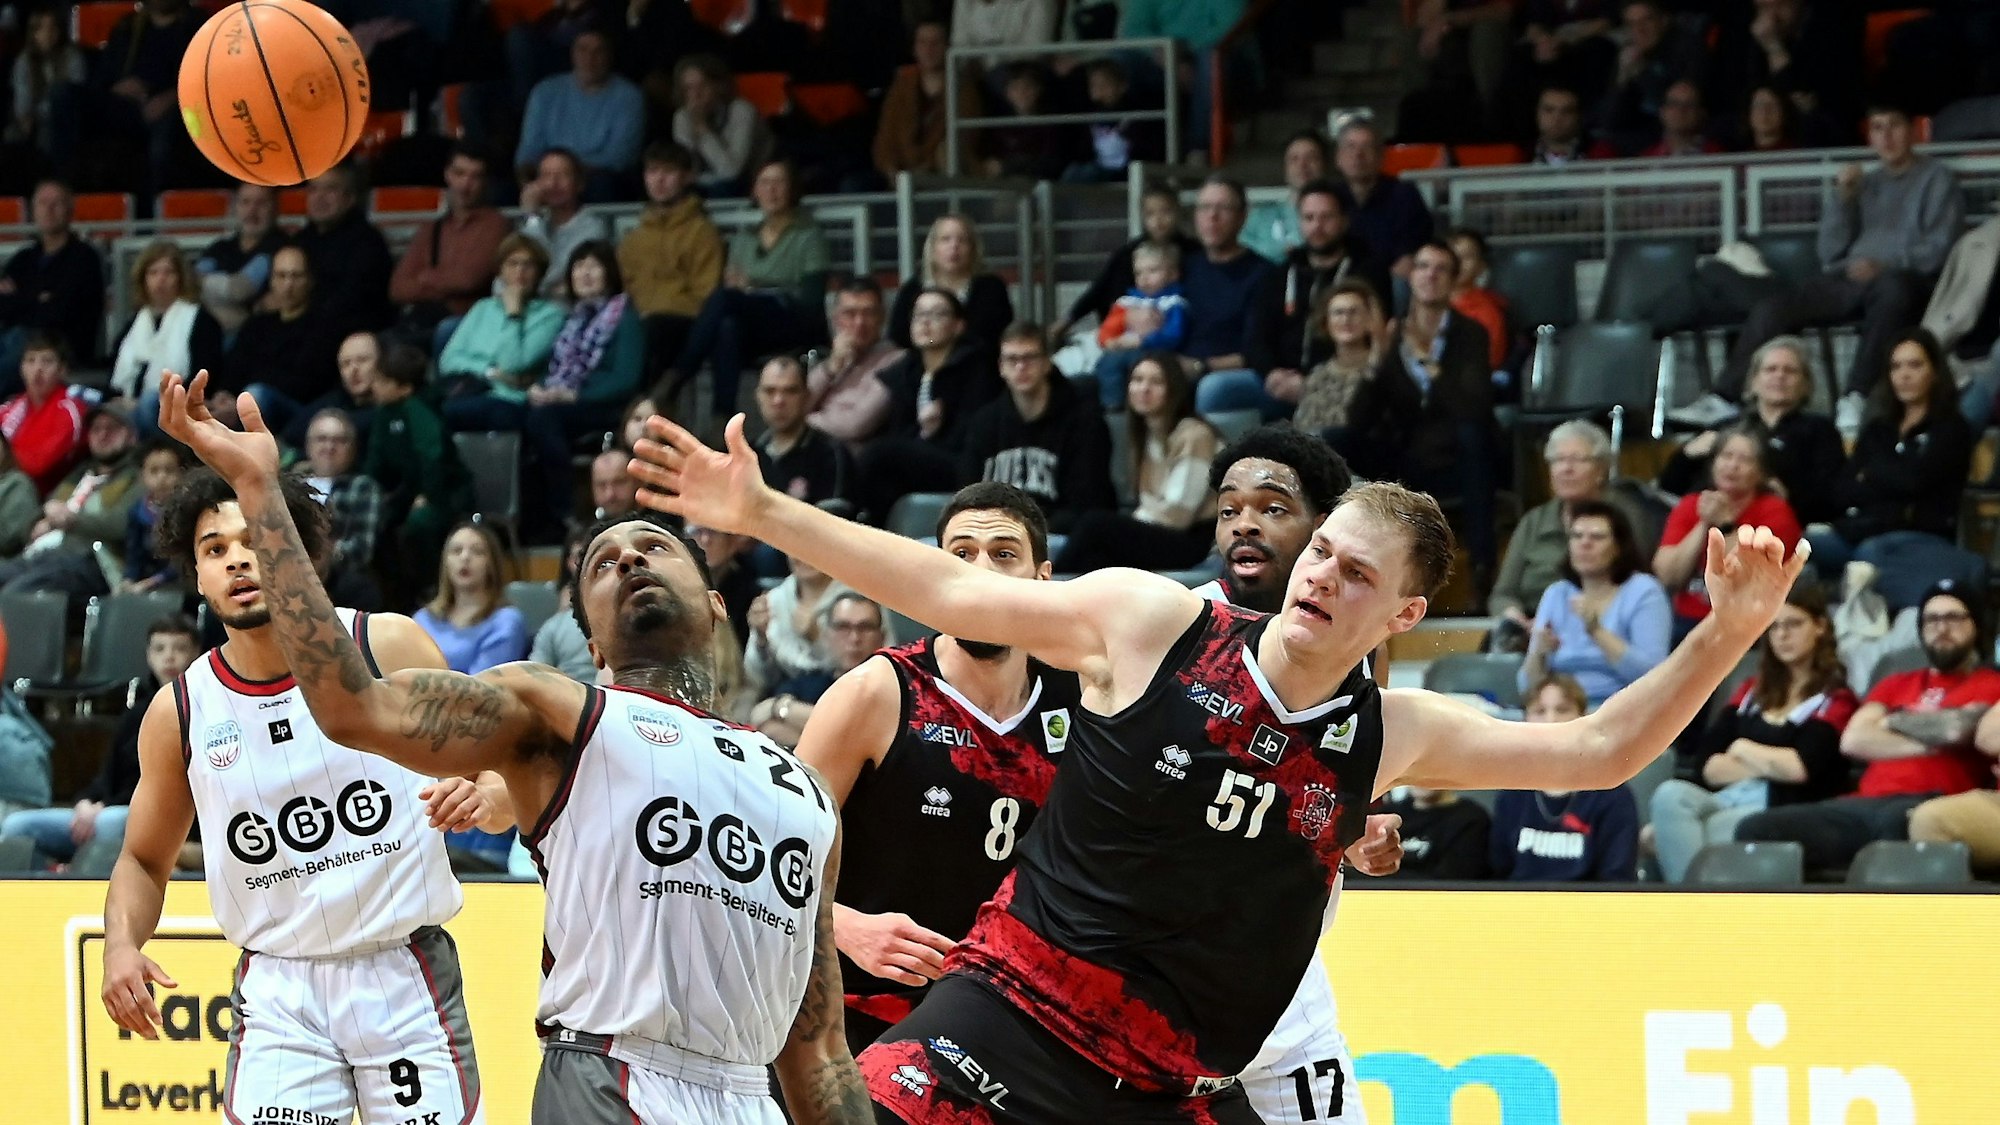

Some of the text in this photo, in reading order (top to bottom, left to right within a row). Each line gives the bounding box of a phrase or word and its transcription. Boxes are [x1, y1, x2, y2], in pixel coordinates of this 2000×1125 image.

[1204, 692, 1245, 726] EVL
[941, 726, 978, 748] EVL
[1154, 759, 1187, 780] errea
[921, 804, 951, 818] errea
[1206, 768, 1276, 839] 51
[984, 797, 1020, 861] 8
[388, 1057, 423, 1108] 9
[889, 1072, 925, 1097] errea
[957, 1055, 1009, 1111] EVL
[1287, 1058, 1345, 1122] 17
